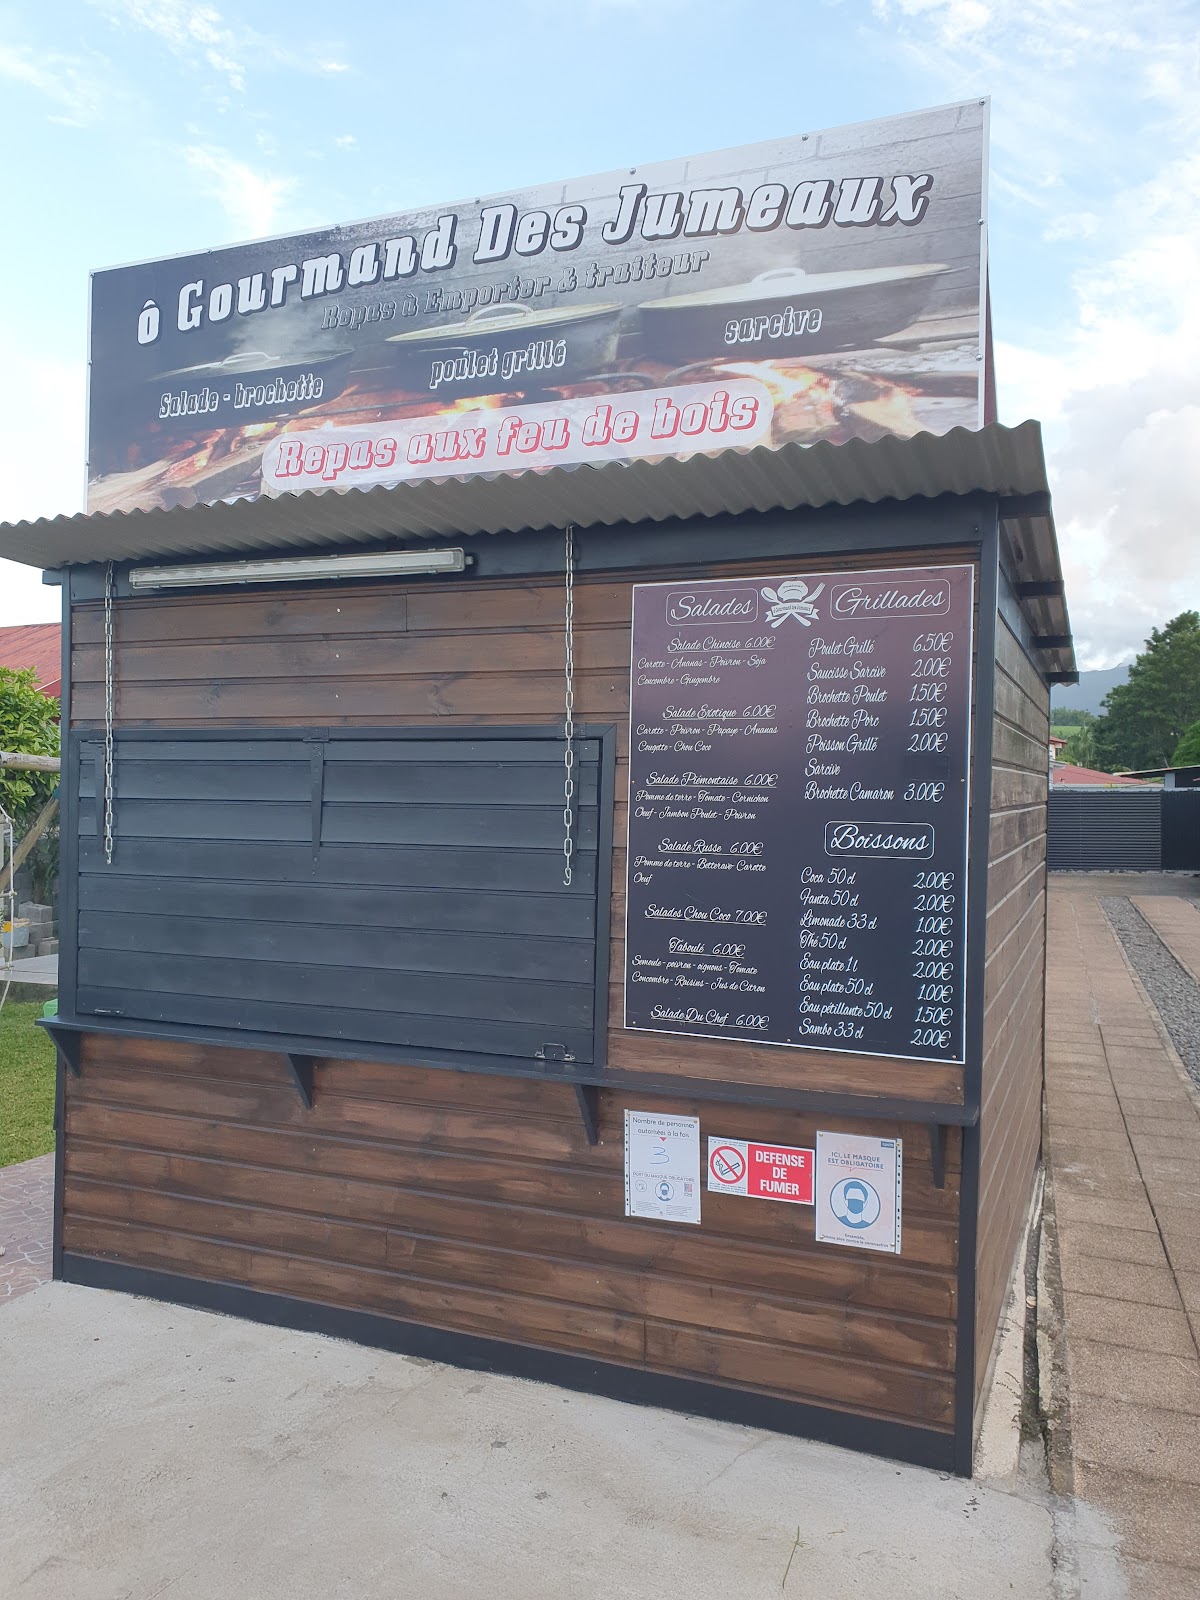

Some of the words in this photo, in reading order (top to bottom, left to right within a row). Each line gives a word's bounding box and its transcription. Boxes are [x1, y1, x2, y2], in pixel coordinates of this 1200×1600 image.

[177, 214, 457, 332] Gourmand
[473, 204, 588, 264] Des
[602, 174, 934, 246] Jumeaux
[320, 304, 396, 330] Repas
[401, 293, 419, 317] à
[423, 274, 551, 315] Emporter
[556, 266, 578, 293] &
[585, 250, 711, 289] traiteur
[724, 306, 823, 344] sarcive
[429, 347, 499, 389] poulet
[501, 339, 567, 380] grillé
[158, 389, 220, 419] Salade
[234, 376, 324, 408] brochette
[274, 434, 398, 480] Repas
[406, 426, 486, 464] aux
[496, 414, 571, 456] feu
[582, 403, 640, 446] de
[650, 390, 761, 439] bois
[671, 596, 753, 620] Salades
[835, 588, 946, 615] Grillades
[667, 638, 701, 652] Salade
[703, 636, 741, 650] Chinoise
[745, 636, 776, 648] 6.00€
[809, 638, 843, 658] Poulet
[844, 636, 875, 657] Grillé
[913, 632, 953, 652] 6.50€
[638, 658, 665, 669] Carotte
[671, 656, 703, 669] Ananas
[710, 655, 741, 668] Poivron
[747, 655, 766, 667] Soja
[807, 662, 848, 681] Saucisse
[850, 661, 886, 680] Sarcive
[911, 657, 951, 677] 2.00€
[680, 674, 720, 686] Gingembre
[807, 685, 850, 704] Brochette
[852, 685, 888, 705] Poulet
[662, 706, 696, 719] Salade
[697, 704, 737, 721] Exotique
[743, 705, 776, 717] 6.00€
[806, 709, 849, 728] Brochette
[851, 709, 879, 729] Porc
[637, 724, 664, 735] Carotte
[670, 724, 701, 735] Poivron
[707, 724, 738, 736] Papaye
[744, 723, 778, 735] Ananas
[674, 741, 693, 751] Chou
[694, 741, 711, 751] Coco
[806, 734, 845, 753] Poisson
[846, 733, 879, 754] Grillé
[908, 733, 948, 752] 2.00€
[805, 758, 841, 777] Sarcive
[646, 772, 679, 785] Salade
[681, 772, 738, 786] Piémontaise
[744, 774, 778, 786] 6.00€
[636, 790, 664, 801] Pomme
[674, 793, 692, 801] terre
[698, 790, 725, 802] Tomate
[732, 791, 769, 803] Cornichon
[804, 781, 848, 800] Brochette
[850, 782, 894, 801] Camaron
[904, 782, 945, 802] 3.00€
[635, 806, 654, 819] Oeuf
[659, 806, 689, 819] Jambon
[690, 808, 717, 819] Poulet
[724, 809, 756, 820] Poivron
[658, 838, 692, 852] Salade
[692, 839, 722, 853] Russe
[730, 842, 763, 855] 6.00€
[830, 824, 929, 850] Boissons
[634, 856, 663, 867] Pomme
[663, 859, 673, 867] de
[673, 860, 691, 868] terre
[736, 860, 766, 872] Carotte
[634, 872, 653, 885] Oeuf
[801, 867, 824, 884] Coca
[828, 868, 846, 885] 50
[913, 872, 955, 891] 2.00€
[800, 887, 830, 906] Fanta
[830, 890, 850, 906] 50
[914, 895, 955, 913] 2.00€
[645, 904, 682, 917] Salades
[684, 906, 708, 920] Chou
[709, 907, 730, 921] Coco
[735, 910, 767, 924] 7.00€
[800, 909, 846, 928] Limonade
[847, 913, 868, 929] 33
[916, 917, 953, 935] 1.00€
[669, 937, 705, 953] Taboulé
[713, 944, 746, 957] 6.00€
[800, 929, 818, 949] Thé
[819, 932, 838, 949] 50
[912, 939, 954, 958] 2.00€
[632, 955, 662, 966] Semoule
[666, 961, 692, 969] poivron
[697, 963, 723, 973] oignons
[729, 961, 758, 974] Tomate
[800, 952, 821, 970] Eau
[821, 959, 845, 974] plate
[913, 962, 954, 981] 2.00€
[632, 971, 669, 984] Concombre
[674, 975, 704, 987] Raisins
[711, 977, 729, 990] Jus
[729, 983, 739, 991] de
[739, 980, 765, 992] Citron
[800, 974, 821, 992] Eau
[821, 981, 845, 995] plate
[845, 978, 864, 995] 50
[917, 984, 954, 1003] 1.00€
[650, 1005, 685, 1020] Salade
[685, 1008, 704, 1022] Du
[705, 1009, 729, 1027] Chef
[736, 1015, 769, 1028] 6.00€
[799, 995, 821, 1014] Eau
[820, 1002, 863, 1017] pétillante
[863, 1002, 884, 1019] 50
[799, 1018, 832, 1036] Sambo
[833, 1021, 854, 1038] 33
[911, 1029, 951, 1048] 2.00€
[632, 1117, 657, 1126] Nombre
[638, 1128, 666, 1136] autorisées
[650, 1147, 669, 1164] 3
[756, 1150, 805, 1167] DEFENSE
[840, 1160, 884, 1170] OBLIGATOIRE
[852, 1154, 880, 1162] MASQUE
[773, 1167, 787, 1179] DE
[760, 1179, 799, 1195] FUMER
